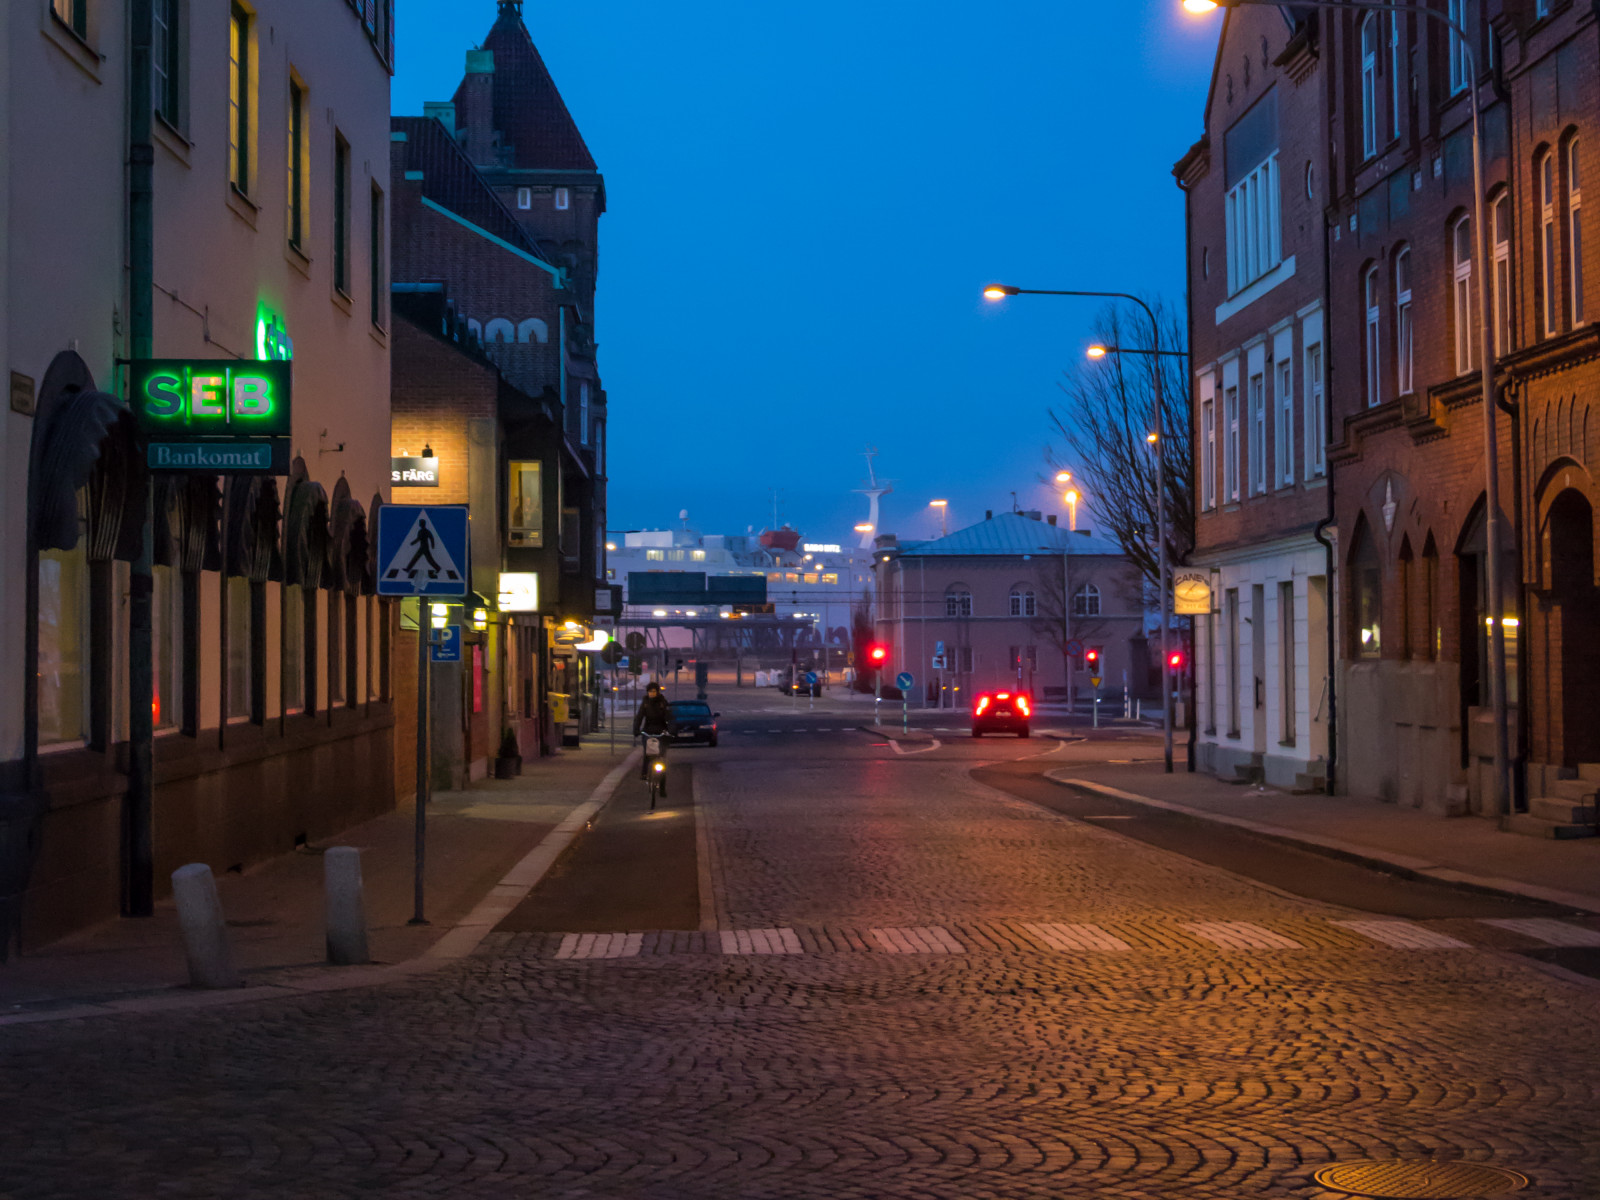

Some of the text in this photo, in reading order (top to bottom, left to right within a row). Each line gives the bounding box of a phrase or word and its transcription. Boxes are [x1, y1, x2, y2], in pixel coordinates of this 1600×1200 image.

[146, 375, 271, 416] SEB
[156, 446, 261, 466] Bankomat
[402, 468, 435, 482] FÄRG
